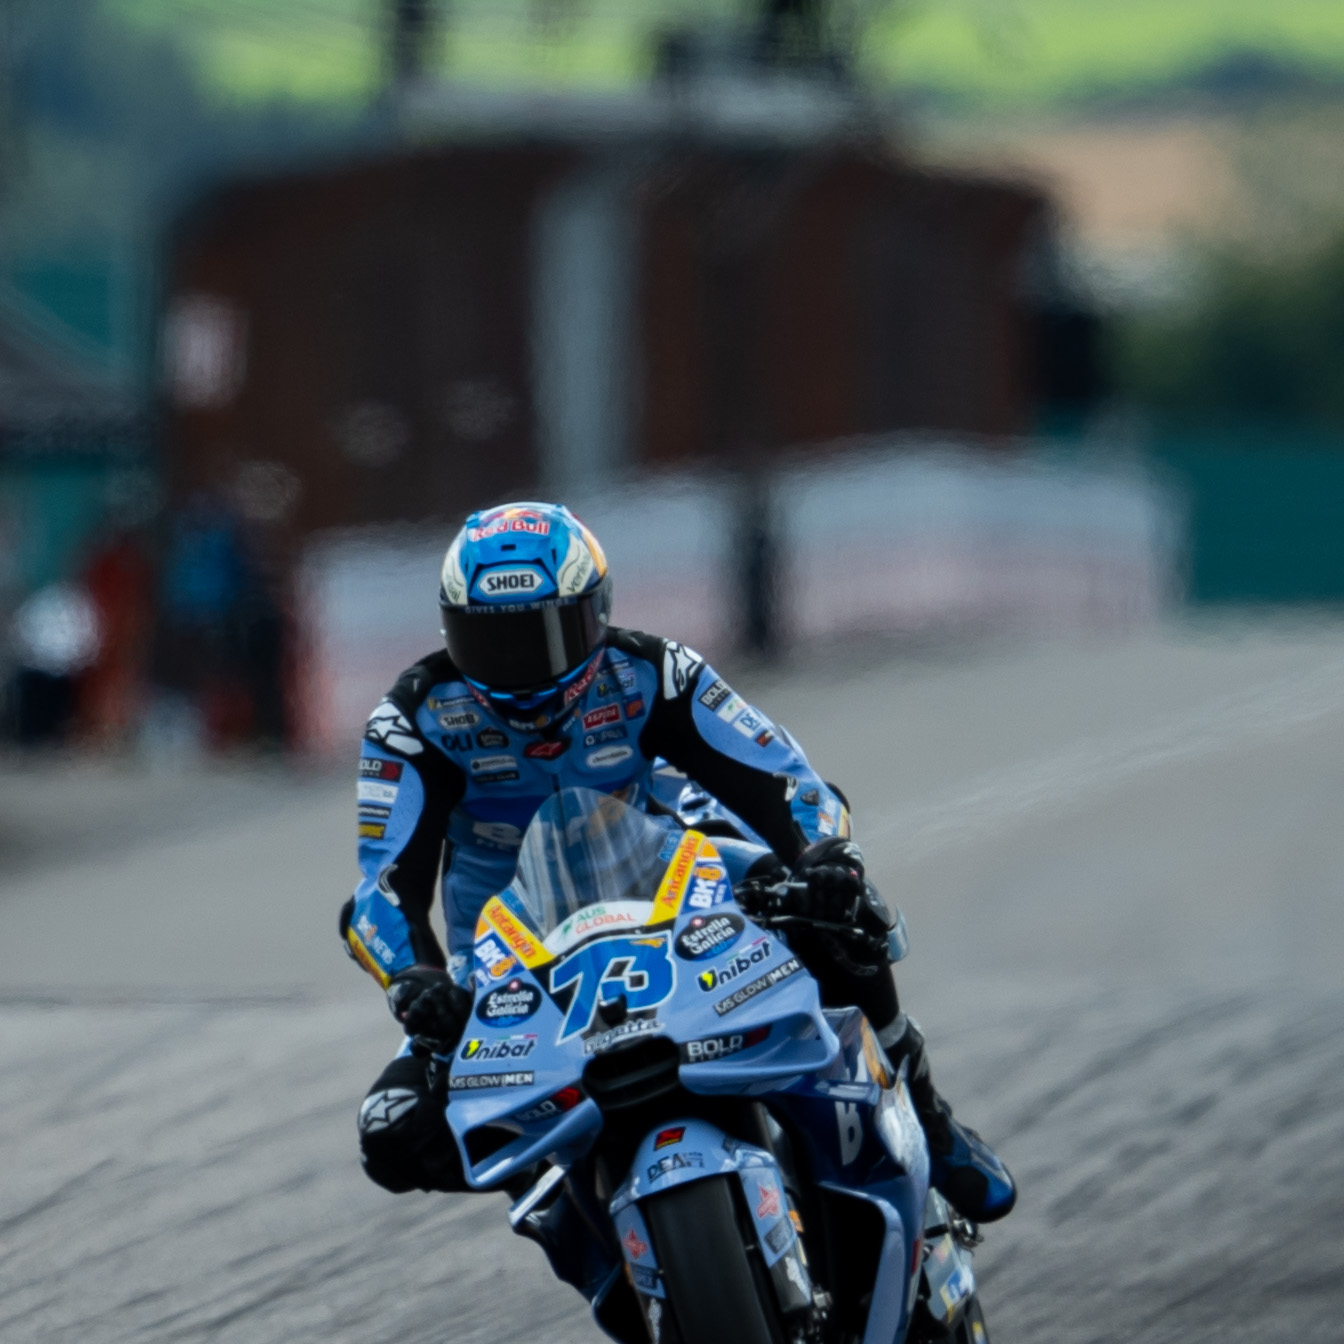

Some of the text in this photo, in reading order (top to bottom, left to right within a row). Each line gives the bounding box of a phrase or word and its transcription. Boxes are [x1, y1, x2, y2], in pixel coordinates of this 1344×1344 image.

[473, 519, 551, 541] Red Bull
[486, 573, 535, 591] SHOEI
[500, 602, 525, 613] YOU
[358, 760, 383, 772] OLD
[575, 912, 636, 935] GLOBAL
[681, 917, 730, 947] Estrella
[690, 926, 736, 955] Galicia
[698, 940, 772, 992] Unibat
[771, 959, 800, 981] MEN
[488, 991, 534, 1006] Estrella
[550, 930, 679, 1047] 73
[460, 1040, 535, 1060] Unibat
[687, 1034, 744, 1058] BOLD
